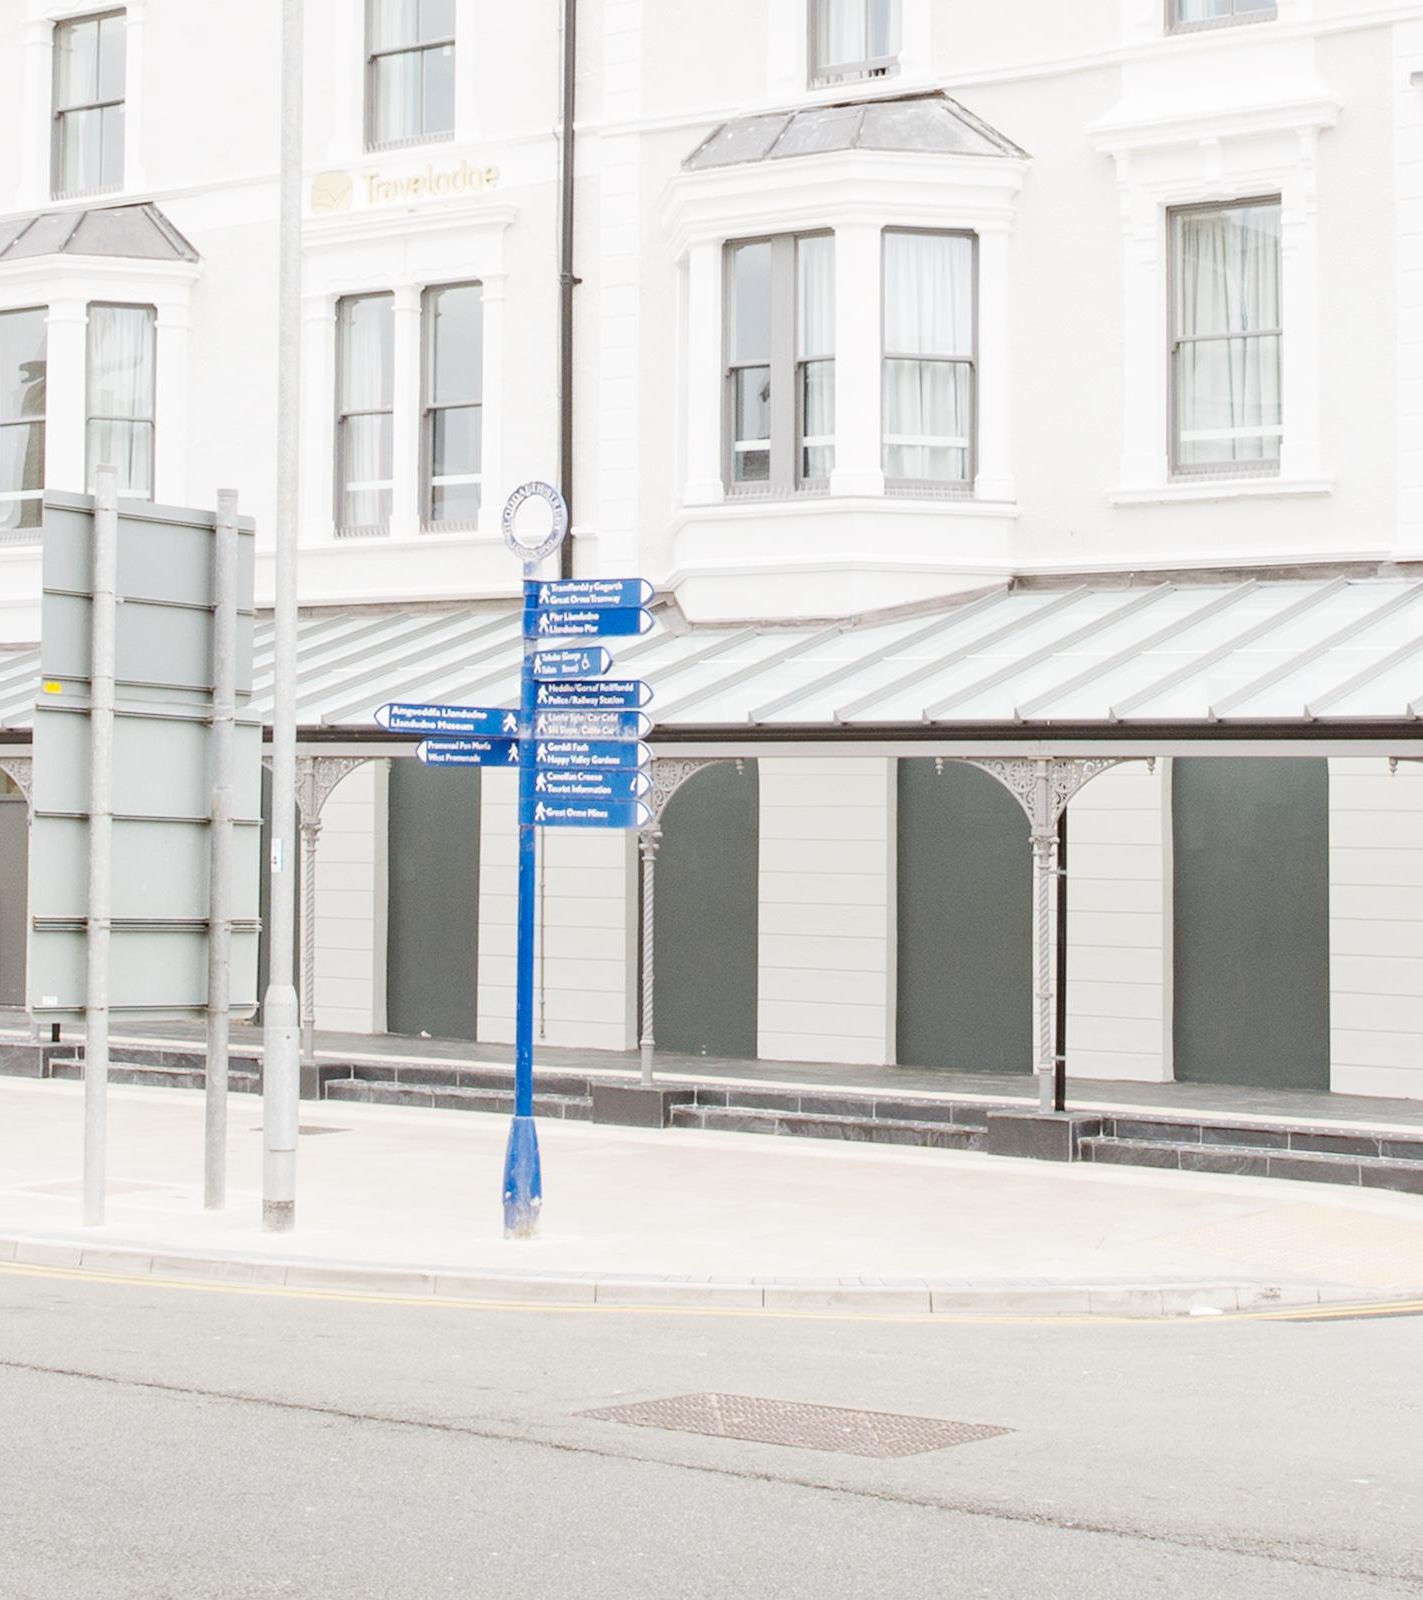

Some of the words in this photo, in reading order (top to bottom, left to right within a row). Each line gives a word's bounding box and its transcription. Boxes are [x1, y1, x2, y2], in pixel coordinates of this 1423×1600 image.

[363, 159, 500, 205] Travelodge
[550, 595, 569, 605] Great
[570, 595, 590, 604] Orme
[590, 594, 621, 604] Tramway
[549, 612, 564, 621] Pier
[564, 612, 600, 621] Llandudno
[549, 624, 584, 634] Llandudno
[584, 623, 599, 633] Pier
[599, 695, 625, 705] Station
[441, 708, 487, 720] Llandudno
[390, 718, 437, 730] Llandudno
[437, 721, 474, 731] Museum
[459, 741, 471, 750] Pen
[427, 753, 445, 762] West
[445, 753, 481, 763] Promenade
[547, 755, 571, 766] Happy
[570, 755, 591, 766] Valley
[591, 755, 621, 765] Gardens
[577, 772, 604, 781] Croeso
[546, 784, 571, 794] Tourist
[572, 785, 612, 795] Information
[545, 807, 566, 817] Great
[566, 807, 587, 817] Orme
[587, 808, 609, 818] Mines
